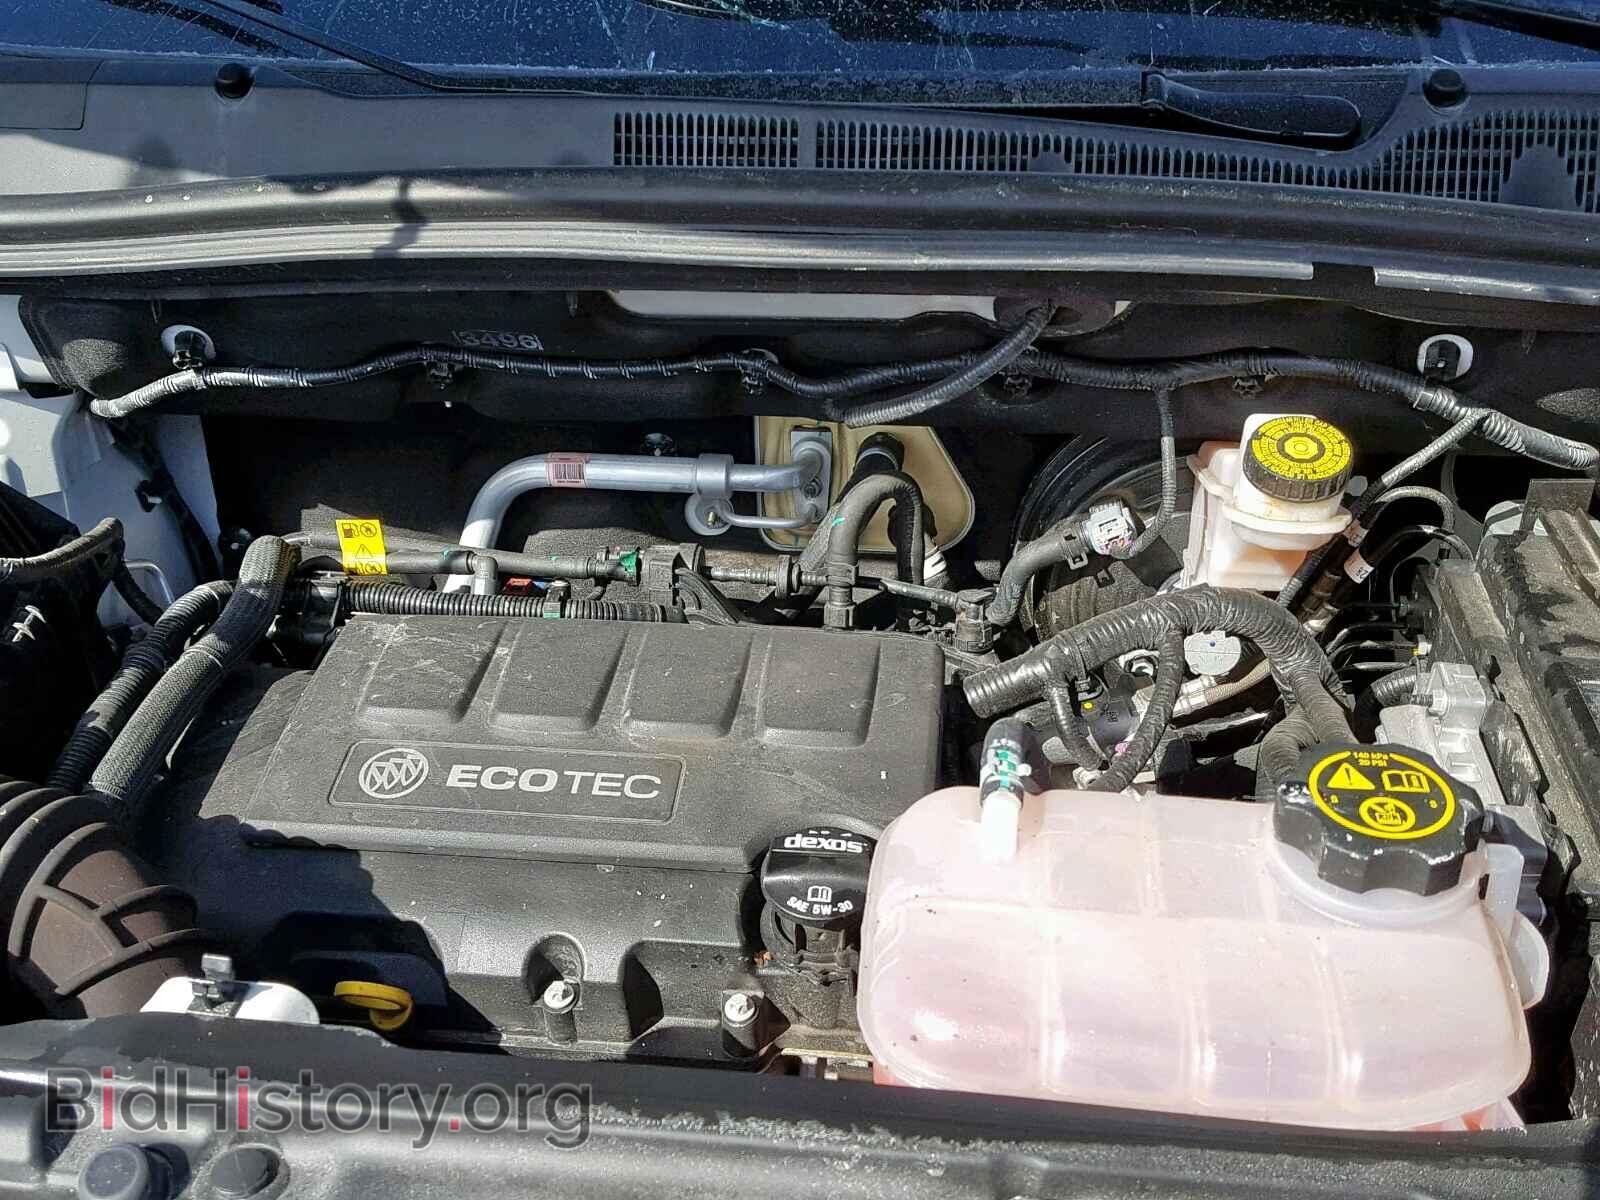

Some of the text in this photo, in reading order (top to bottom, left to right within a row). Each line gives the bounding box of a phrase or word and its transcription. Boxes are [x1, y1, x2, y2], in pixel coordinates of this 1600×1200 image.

[446, 764, 662, 799] ECOTEC
[783, 833, 863, 854] dexos
[786, 896, 854, 916] SAE 5W-30
